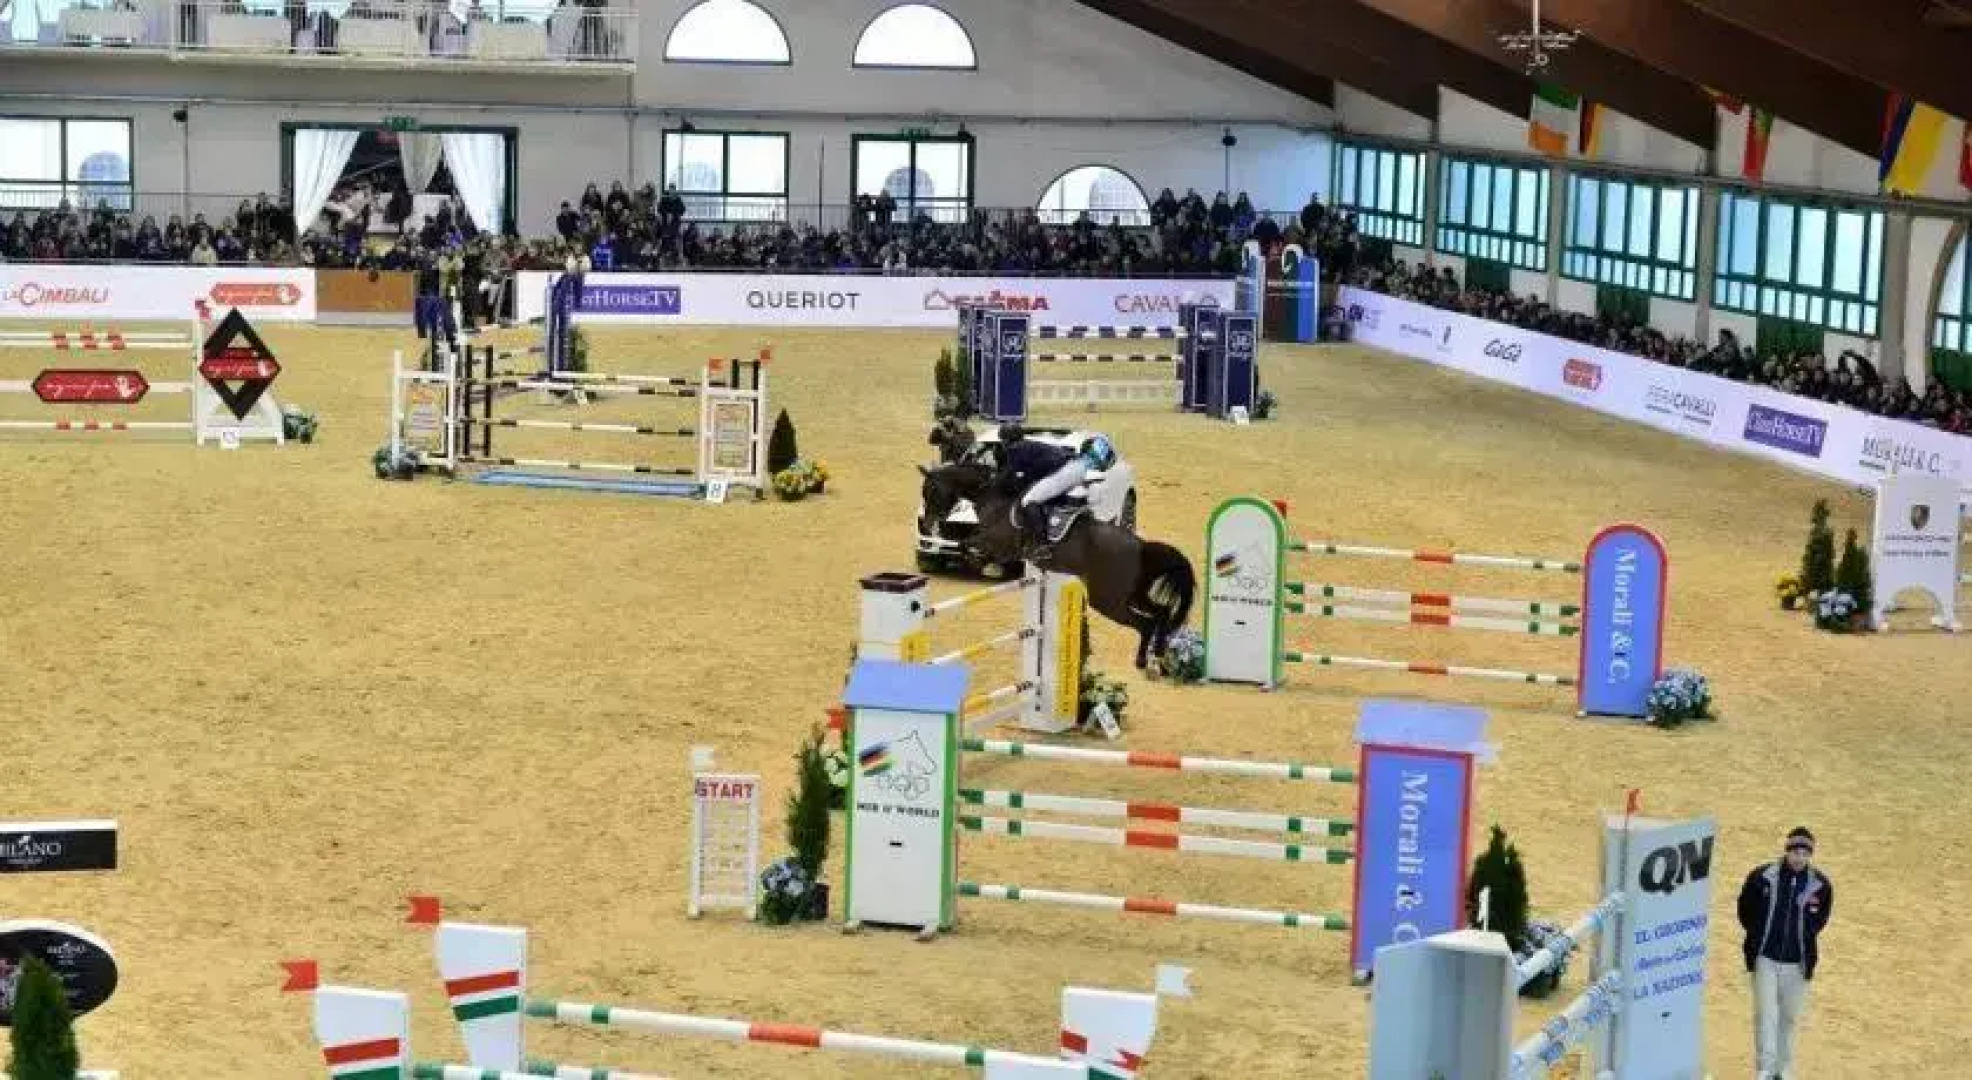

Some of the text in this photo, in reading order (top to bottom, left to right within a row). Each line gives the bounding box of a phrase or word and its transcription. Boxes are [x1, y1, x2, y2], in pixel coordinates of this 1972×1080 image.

[747, 290, 861, 310] QUERIOT
[1614, 547, 1636, 625] Morali
[1612, 630, 1634, 649] &
[695, 781, 754, 799] START
[1397, 769, 1428, 879] Morali
[1638, 835, 1715, 895] QN
[1394, 882, 1424, 911] &
